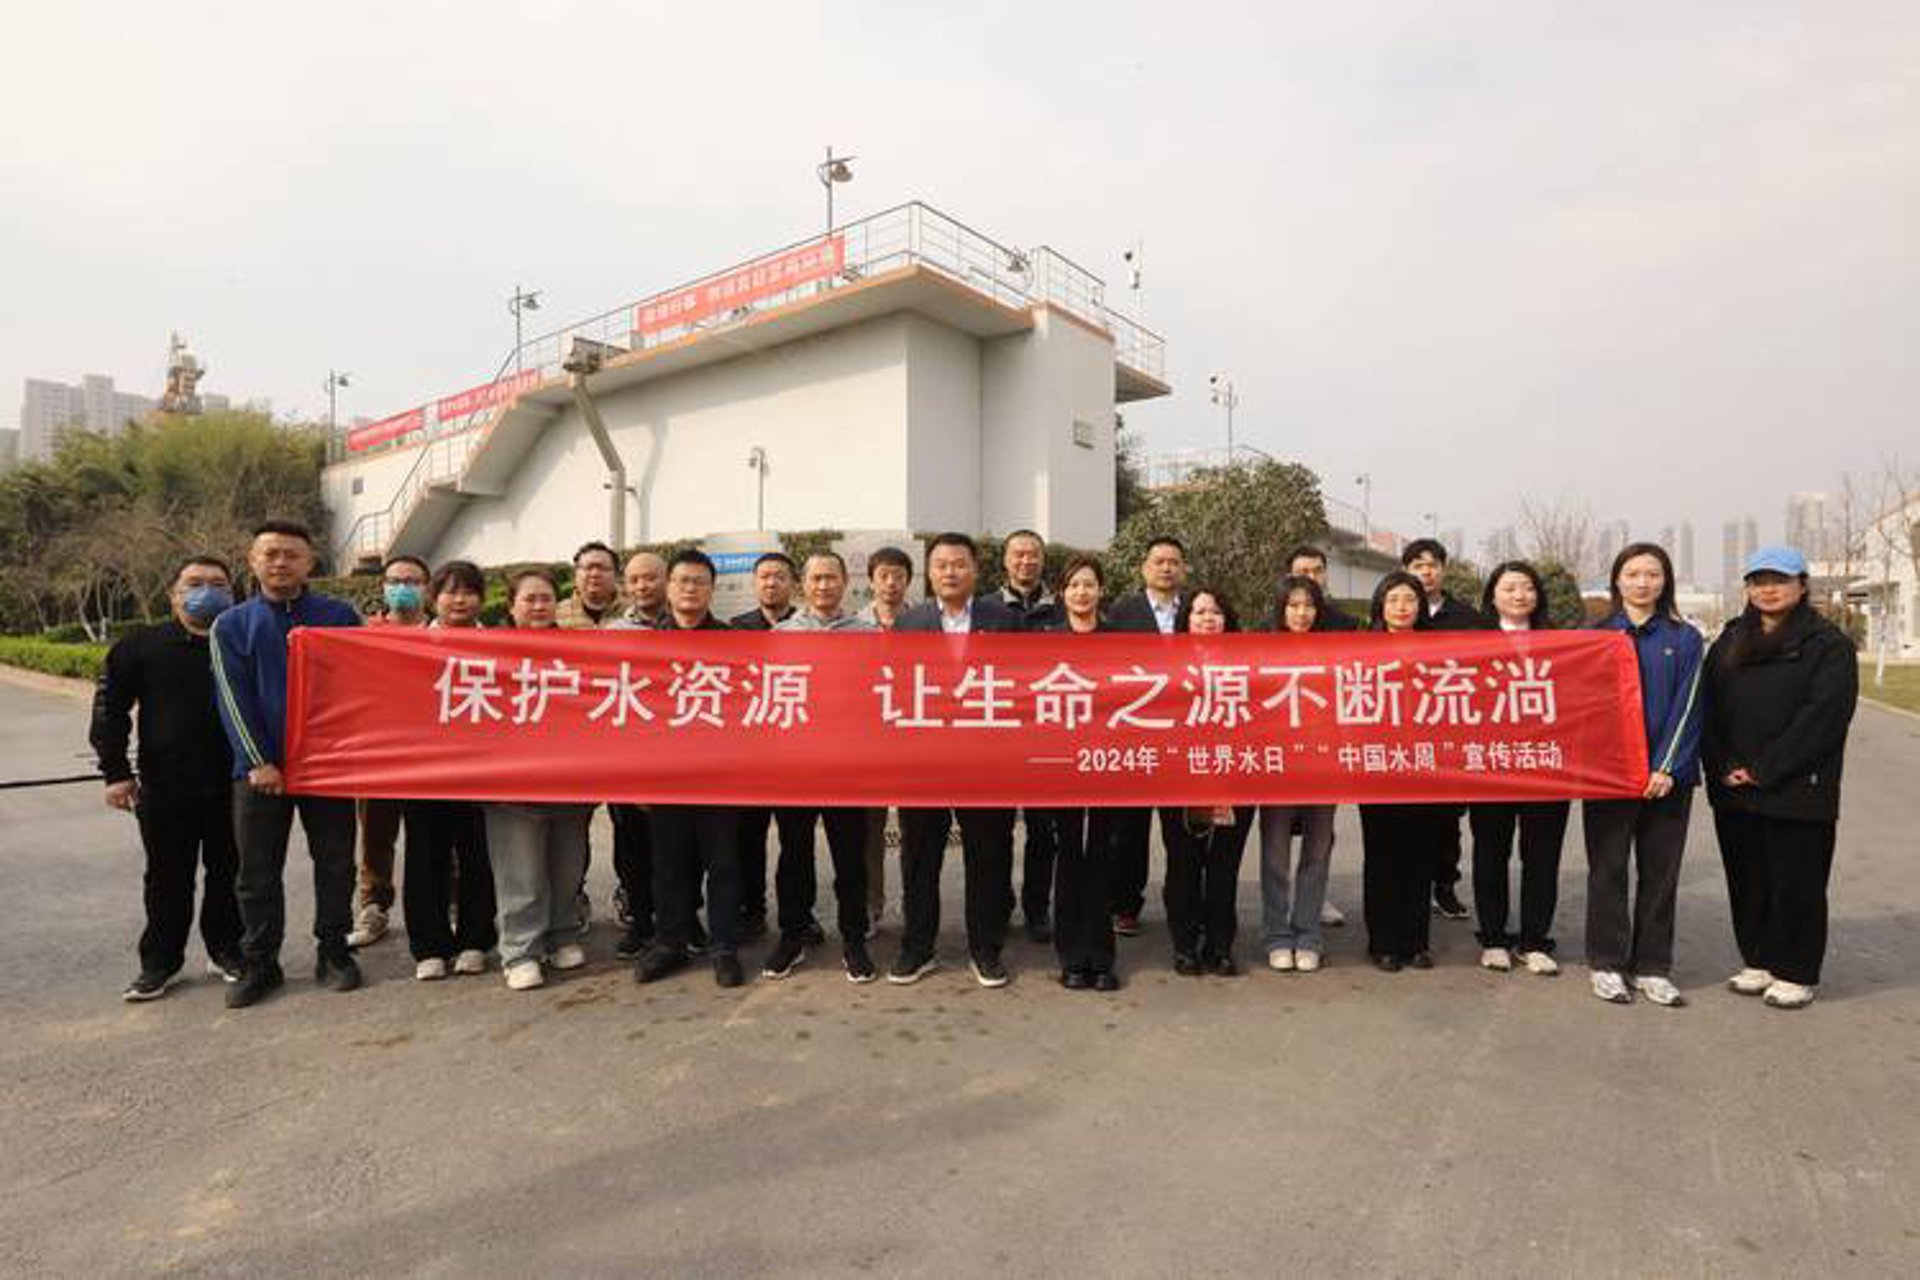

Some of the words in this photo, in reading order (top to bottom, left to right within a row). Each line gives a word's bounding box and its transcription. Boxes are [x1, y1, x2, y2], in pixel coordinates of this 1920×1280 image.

[434, 656, 812, 729] 保护水资源
[872, 658, 1557, 730] 让生命之源不断流淌
